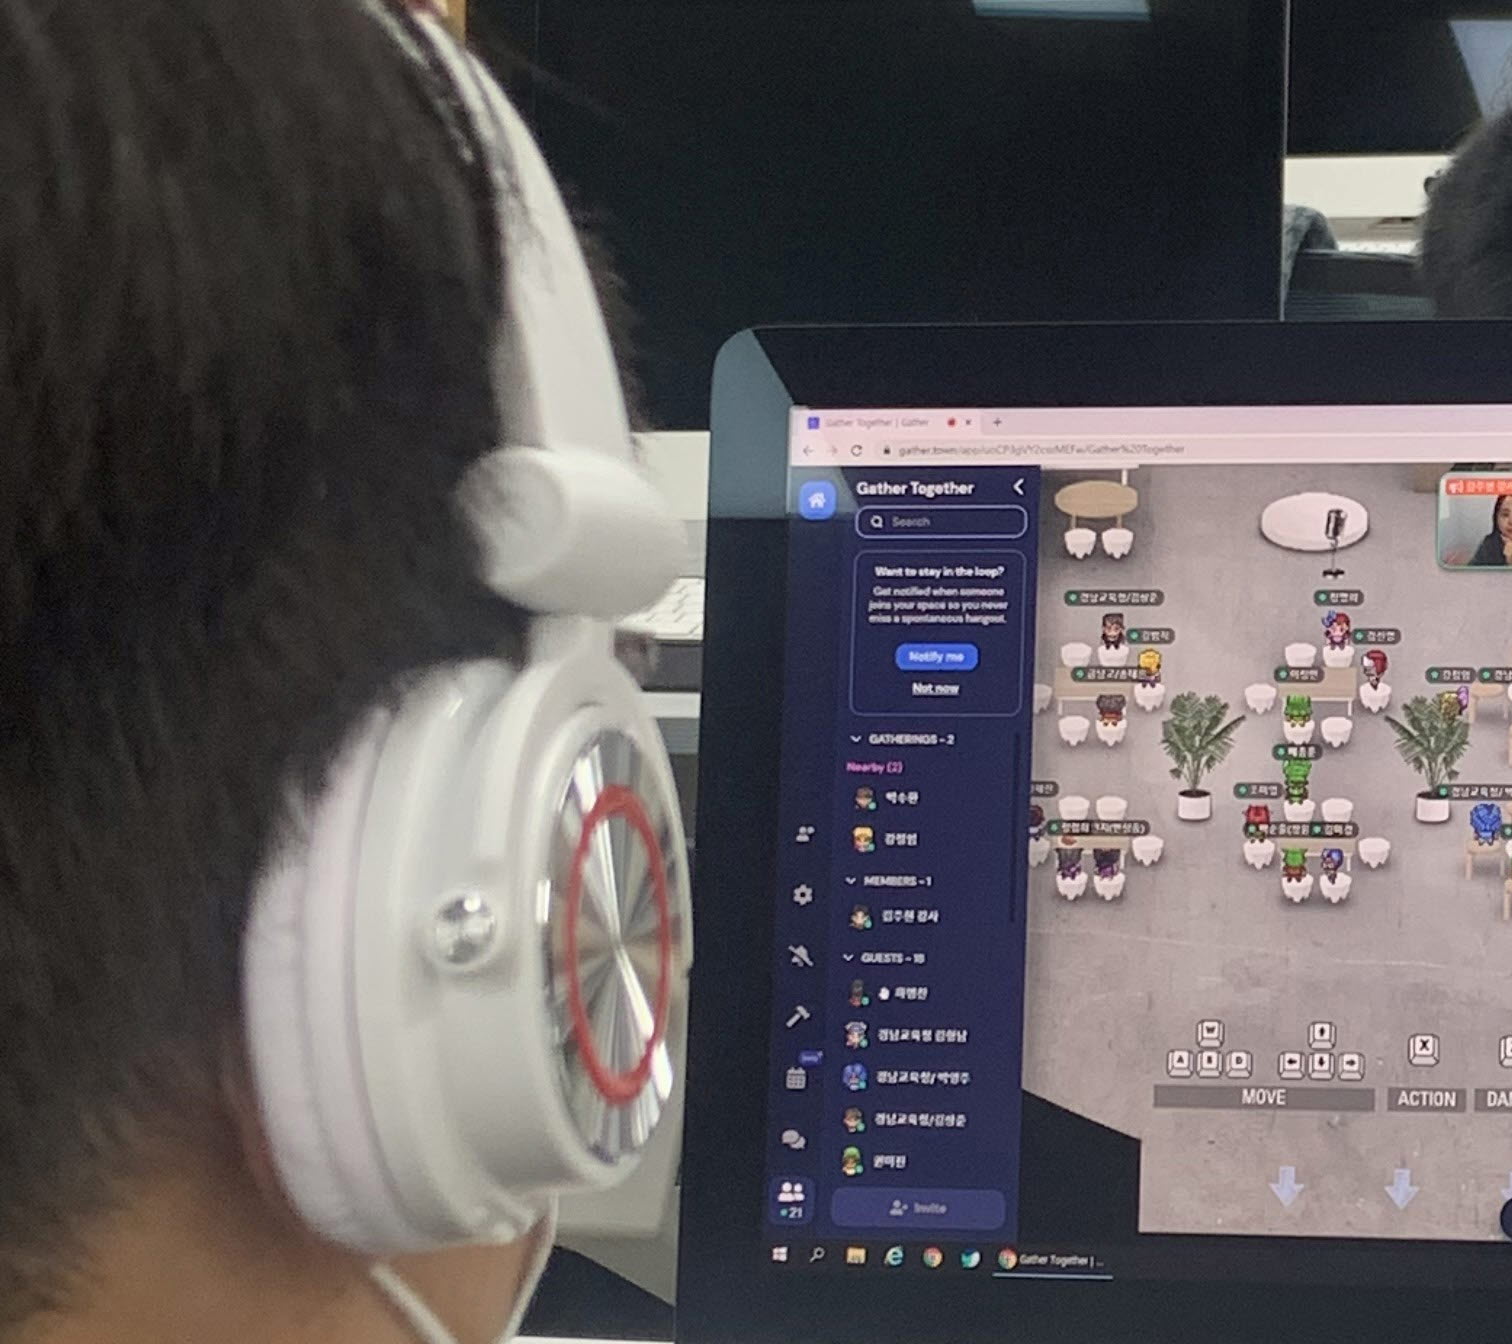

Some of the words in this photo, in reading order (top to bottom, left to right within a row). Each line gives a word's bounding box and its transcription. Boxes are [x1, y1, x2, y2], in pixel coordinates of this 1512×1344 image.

[856, 481, 908, 496] Gather
[911, 481, 976, 499] Together
[891, 515, 931, 528] Search
[875, 566, 902, 578] Want
[904, 566, 916, 578] to
[918, 566, 942, 581] stay
[955, 566, 973, 578] the
[974, 566, 1005, 581] loop?
[890, 586, 930, 597] notified
[931, 586, 958, 597] when
[959, 586, 1005, 597] someone
[908, 651, 943, 664] Notify
[945, 653, 965, 663] me
[912, 683, 929, 695] Not
[930, 683, 960, 696] now
[868, 734, 938, 746] GATHERINGS
[946, 735, 955, 746] 2
[845, 761, 886, 775] Nearby
[887, 761, 904, 774] (2)
[863, 875, 918, 888] MEMBERS
[926, 876, 932, 887] 1
[860, 952, 903, 965] GUESTS
[1418, 1039, 1430, 1052] X
[1241, 1088, 1287, 1107] MOVE
[1397, 1090, 1457, 1108] ACTION
[788, 1206, 803, 1219] 21
[913, 1200, 948, 1216] Invite
[1019, 1254, 1048, 1266] Gather
[1049, 1254, 1089, 1269] Together
